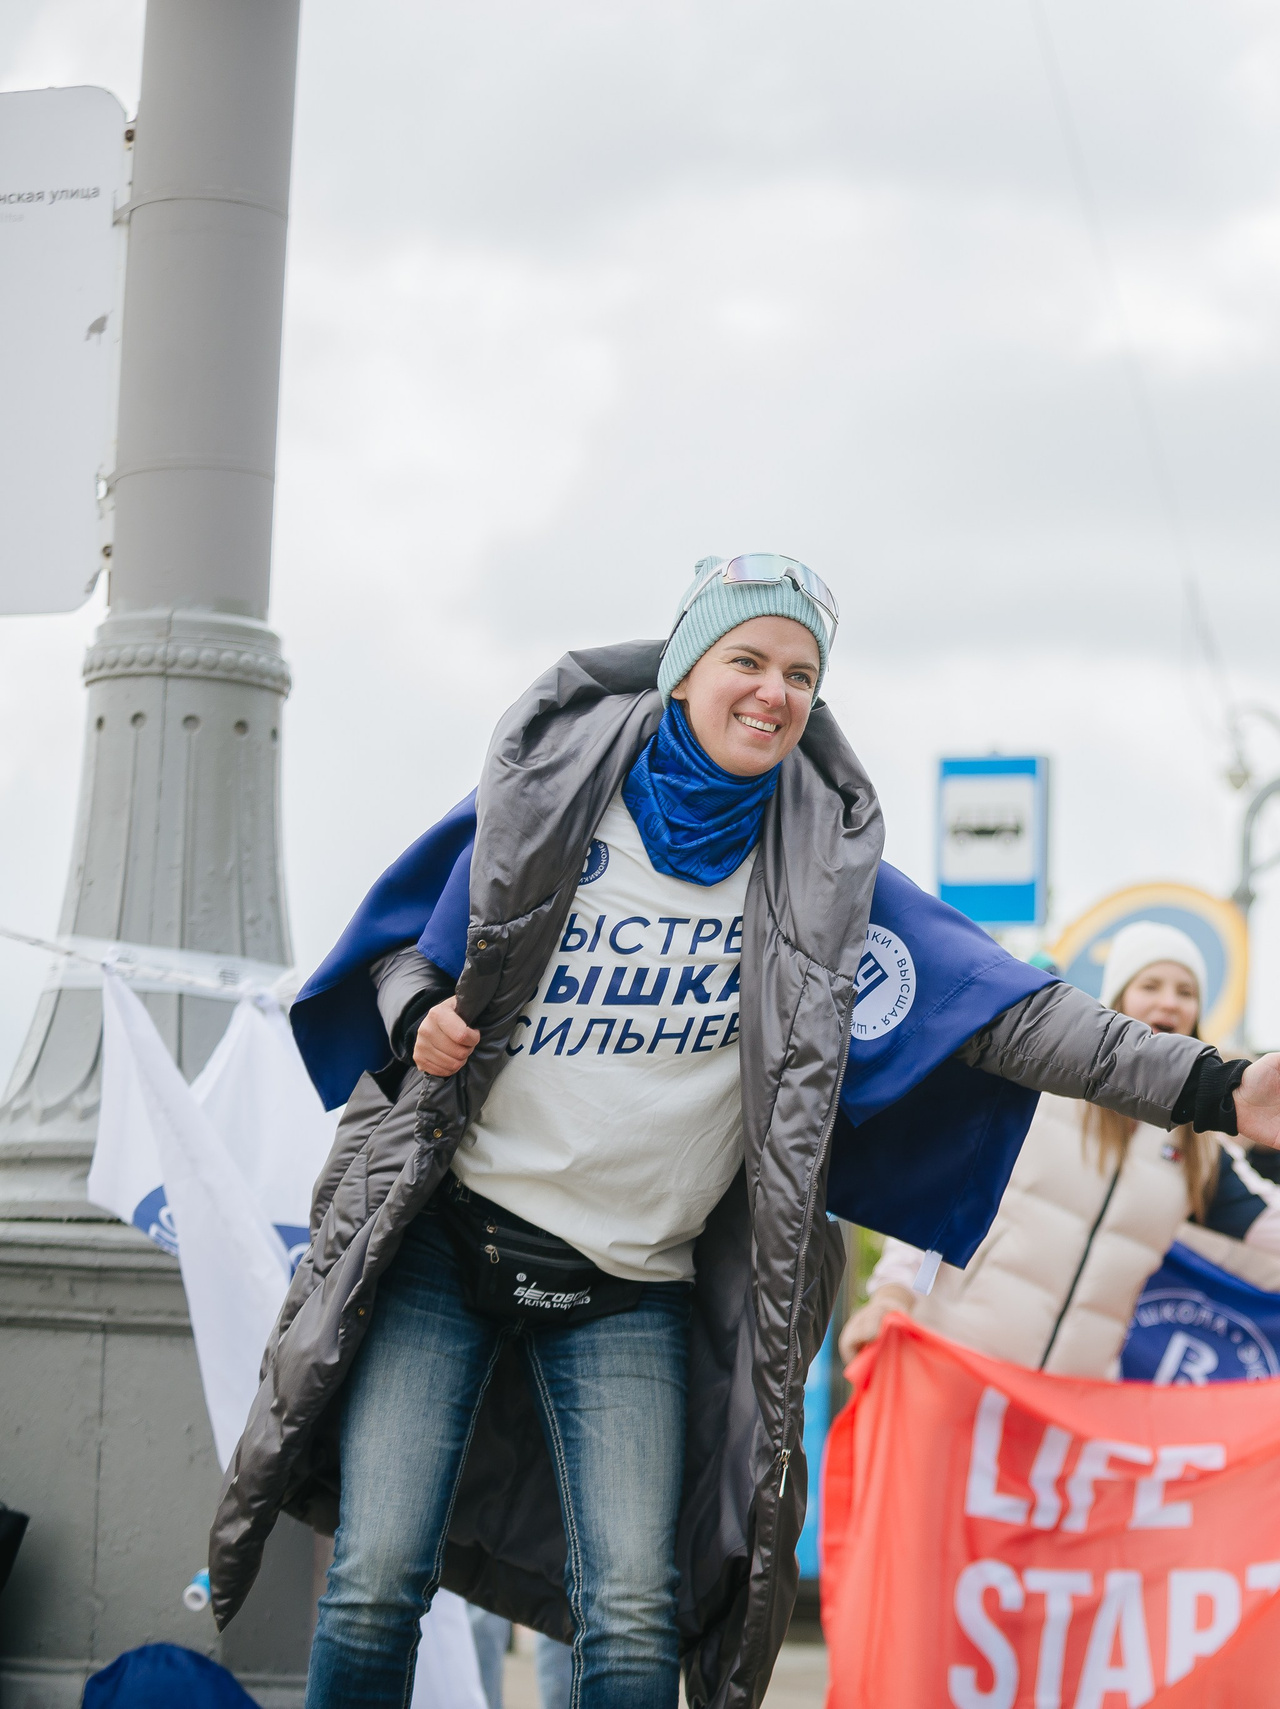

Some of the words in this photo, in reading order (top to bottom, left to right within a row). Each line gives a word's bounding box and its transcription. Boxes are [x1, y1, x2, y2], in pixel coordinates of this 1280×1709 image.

[48, 186, 100, 205] улица
[528, 961, 741, 1006] ЫШКА
[880, 958, 911, 1026] ВЫСШАЯ
[963, 1387, 1226, 1533] LIFE
